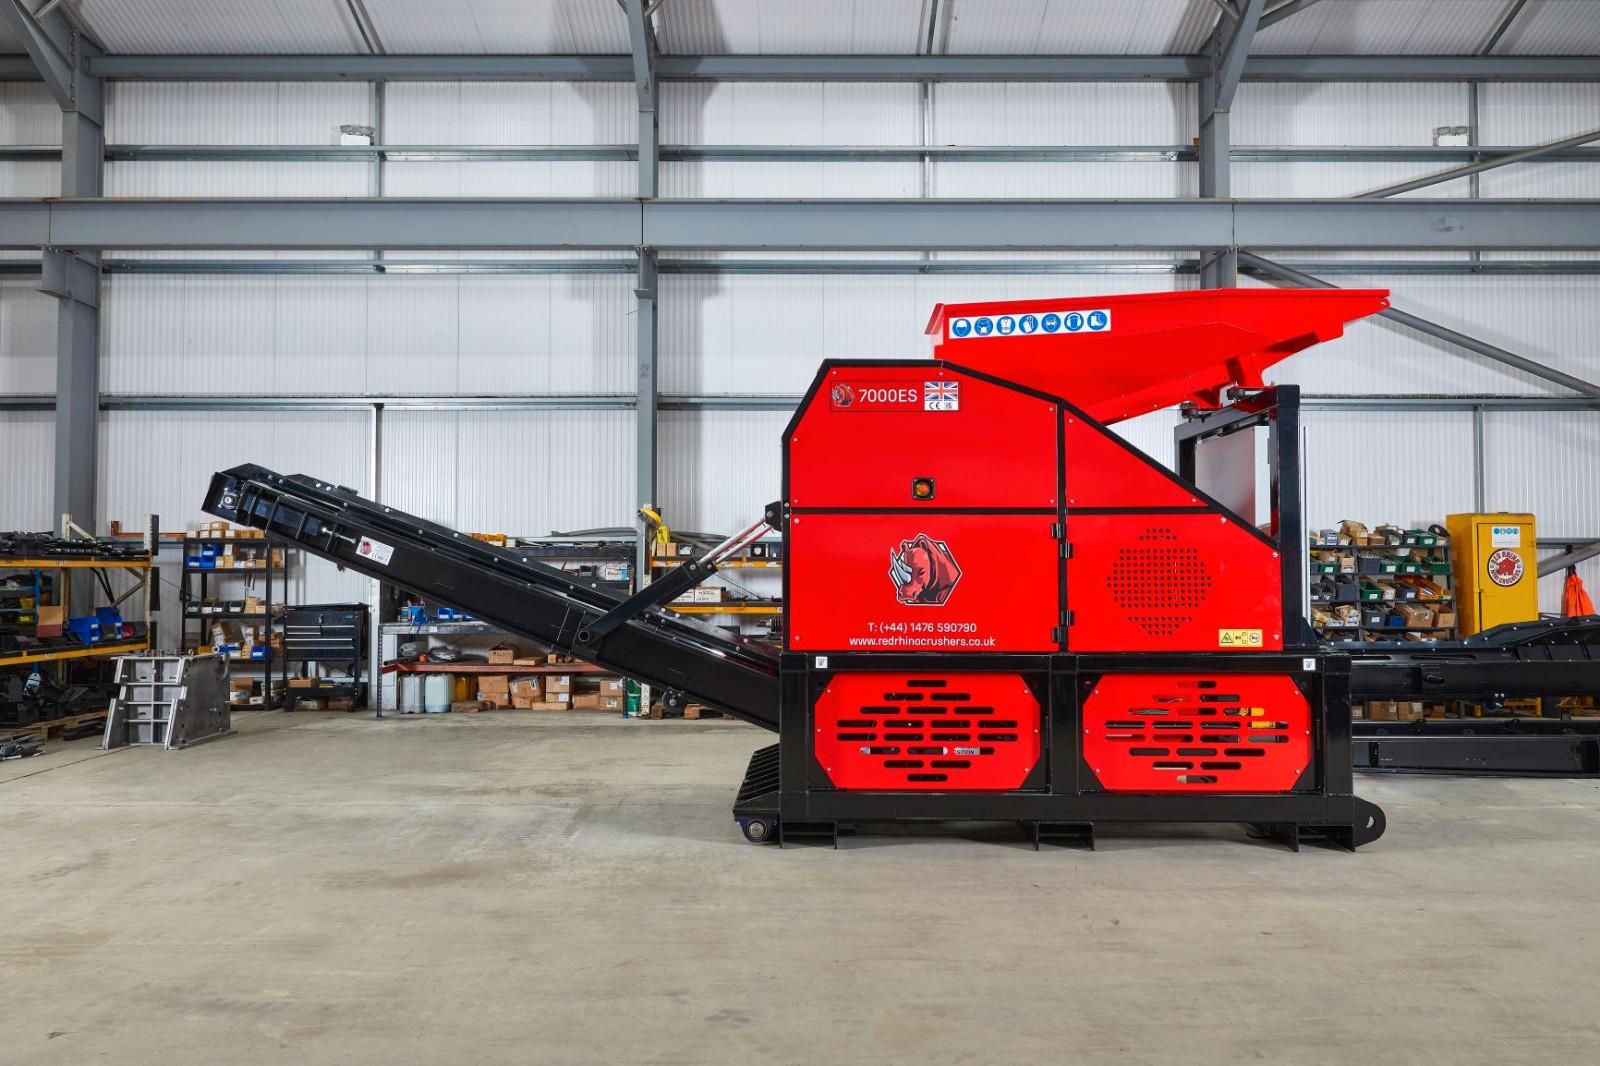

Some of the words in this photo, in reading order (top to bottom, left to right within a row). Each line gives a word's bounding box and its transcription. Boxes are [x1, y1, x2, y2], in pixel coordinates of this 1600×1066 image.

[858, 388, 918, 403] 7000ES
[867, 622, 878, 632] T:
[879, 622, 908, 634] (+44)
[910, 622, 934, 633] 1476
[937, 622, 977, 633] 590790
[849, 636, 996, 647] www.redrhinocrushers.co.uk
